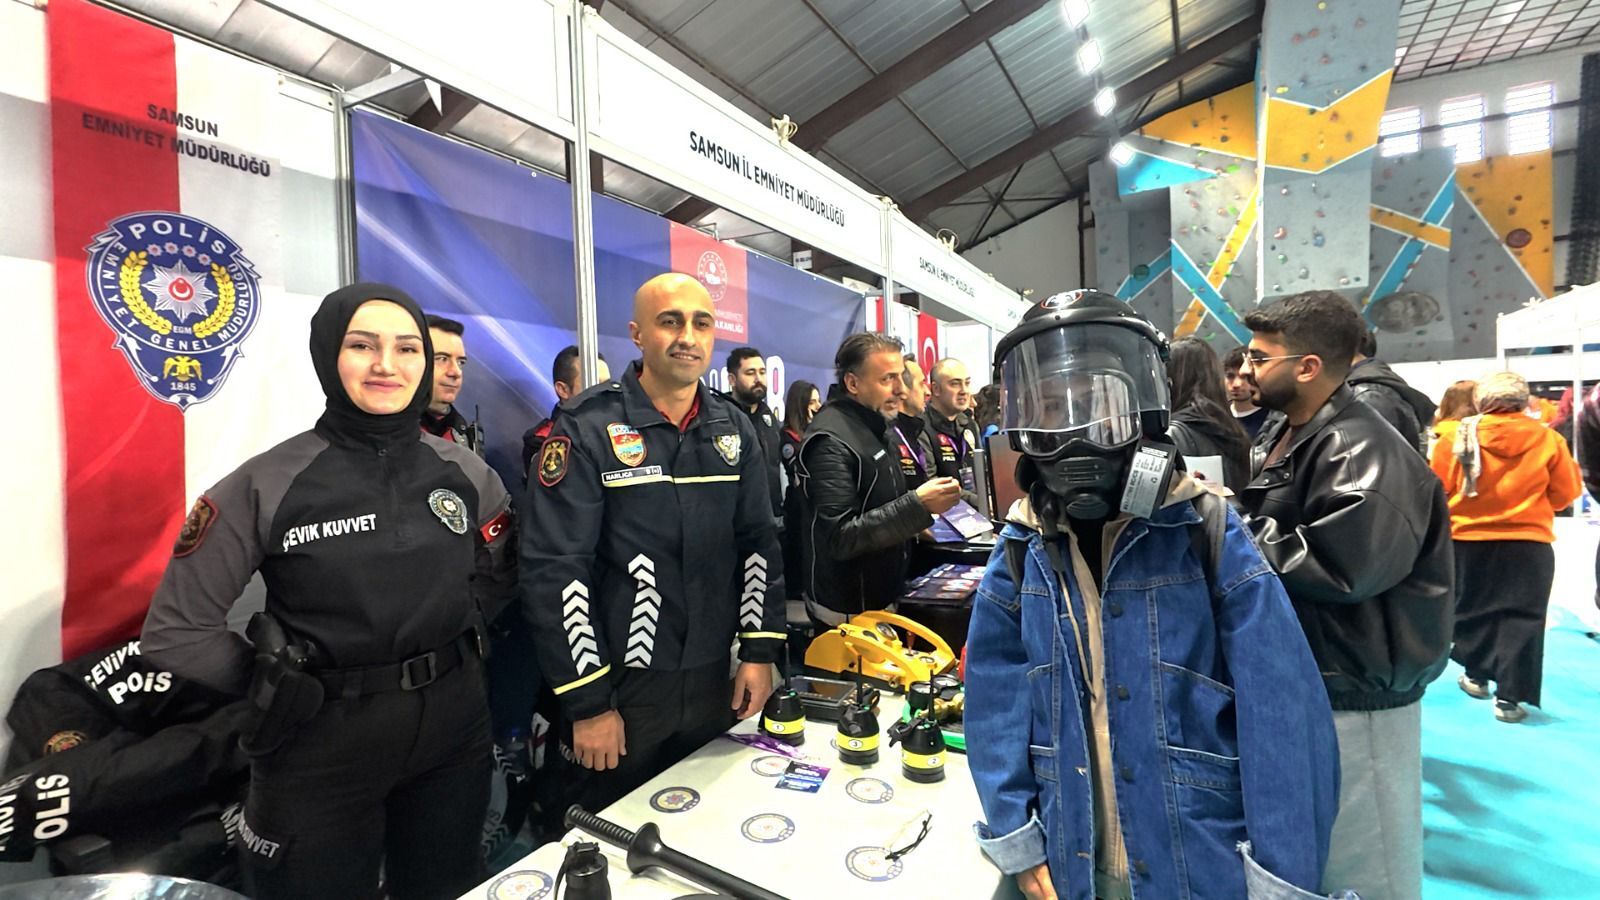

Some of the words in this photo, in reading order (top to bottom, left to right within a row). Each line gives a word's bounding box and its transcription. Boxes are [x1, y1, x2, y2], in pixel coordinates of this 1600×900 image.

[147, 104, 219, 137] SAMSUN
[82, 112, 165, 149] EMNİYET
[171, 138, 271, 177] MÜDÜRLÜĞÜ
[689, 131, 740, 174] SAMSUN
[742, 155, 752, 180] İL
[754, 167, 795, 202] EMNİYET
[796, 189, 845, 227] MÜDÜRLÜĞÜ
[128, 219, 226, 255] POLİS
[102, 242, 140, 329] EMNİYET
[150, 333, 212, 351] GENEL
[173, 325, 192, 335] EGM
[170, 382, 197, 391] 1845
[282, 523, 320, 553] ÇEVİK
[322, 513, 377, 538] KUVVET
[33, 774, 71, 840] OLİS
